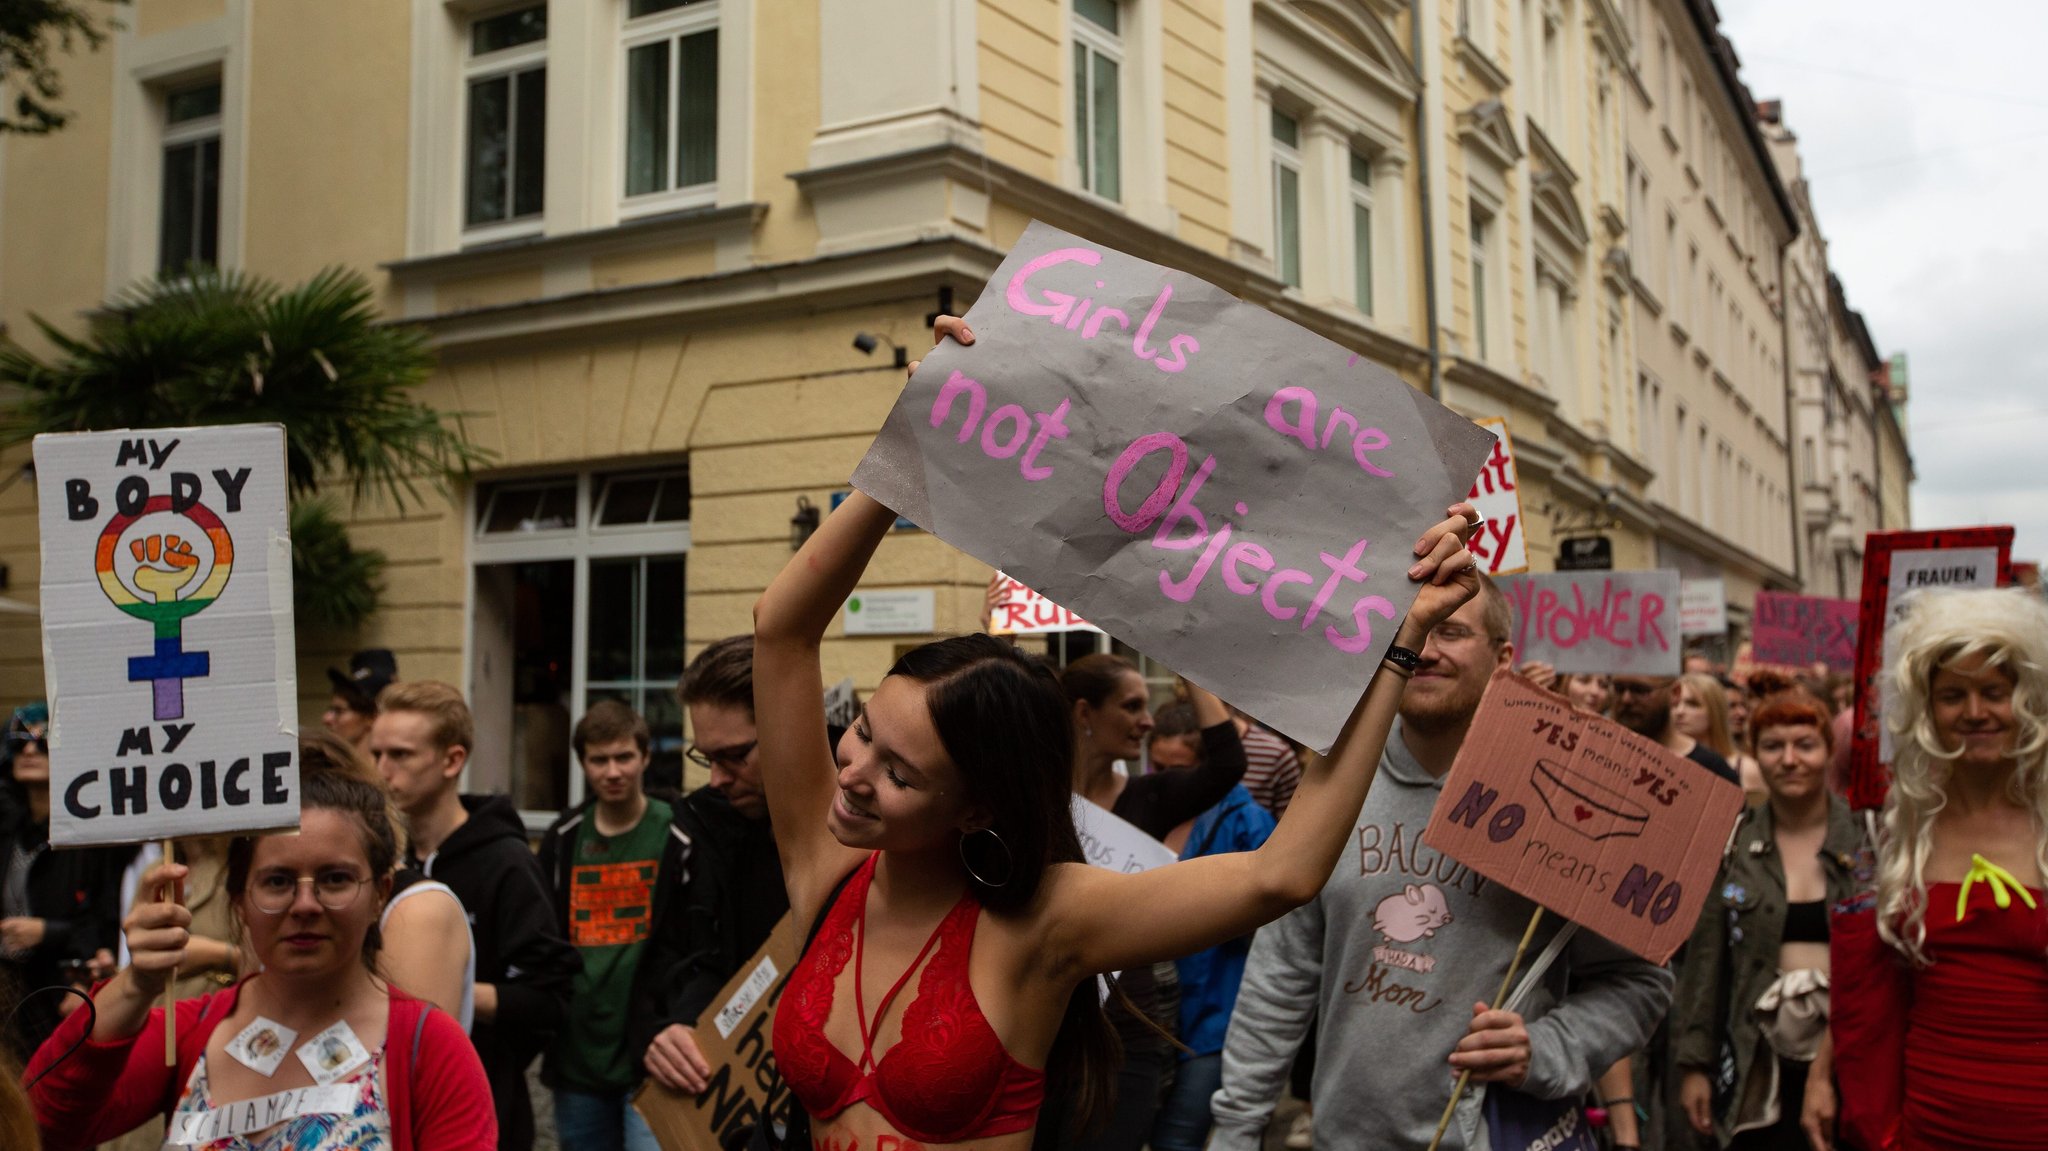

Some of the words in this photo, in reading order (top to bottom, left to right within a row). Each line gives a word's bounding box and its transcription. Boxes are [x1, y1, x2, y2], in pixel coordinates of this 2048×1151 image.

[1007, 247, 1200, 373] Girls
[1264, 386, 1395, 478] are
[115, 438, 181, 470] MY
[65, 467, 252, 521] BODY
[929, 370, 1072, 482] not
[1103, 431, 1396, 654] Objects
[1907, 566, 1977, 585] FRAUEN
[1504, 577, 1669, 663] YPOWER
[116, 722, 195, 757] MY
[1532, 718, 1579, 752] YES
[1582, 748, 1632, 778] means
[1633, 767, 1679, 806] YES
[63, 751, 292, 819] CHOICE
[1448, 780, 1526, 843] NO
[1522, 839, 1612, 893] means
[1611, 864, 1682, 925] NO
[1343, 963, 1442, 1013] Mom
